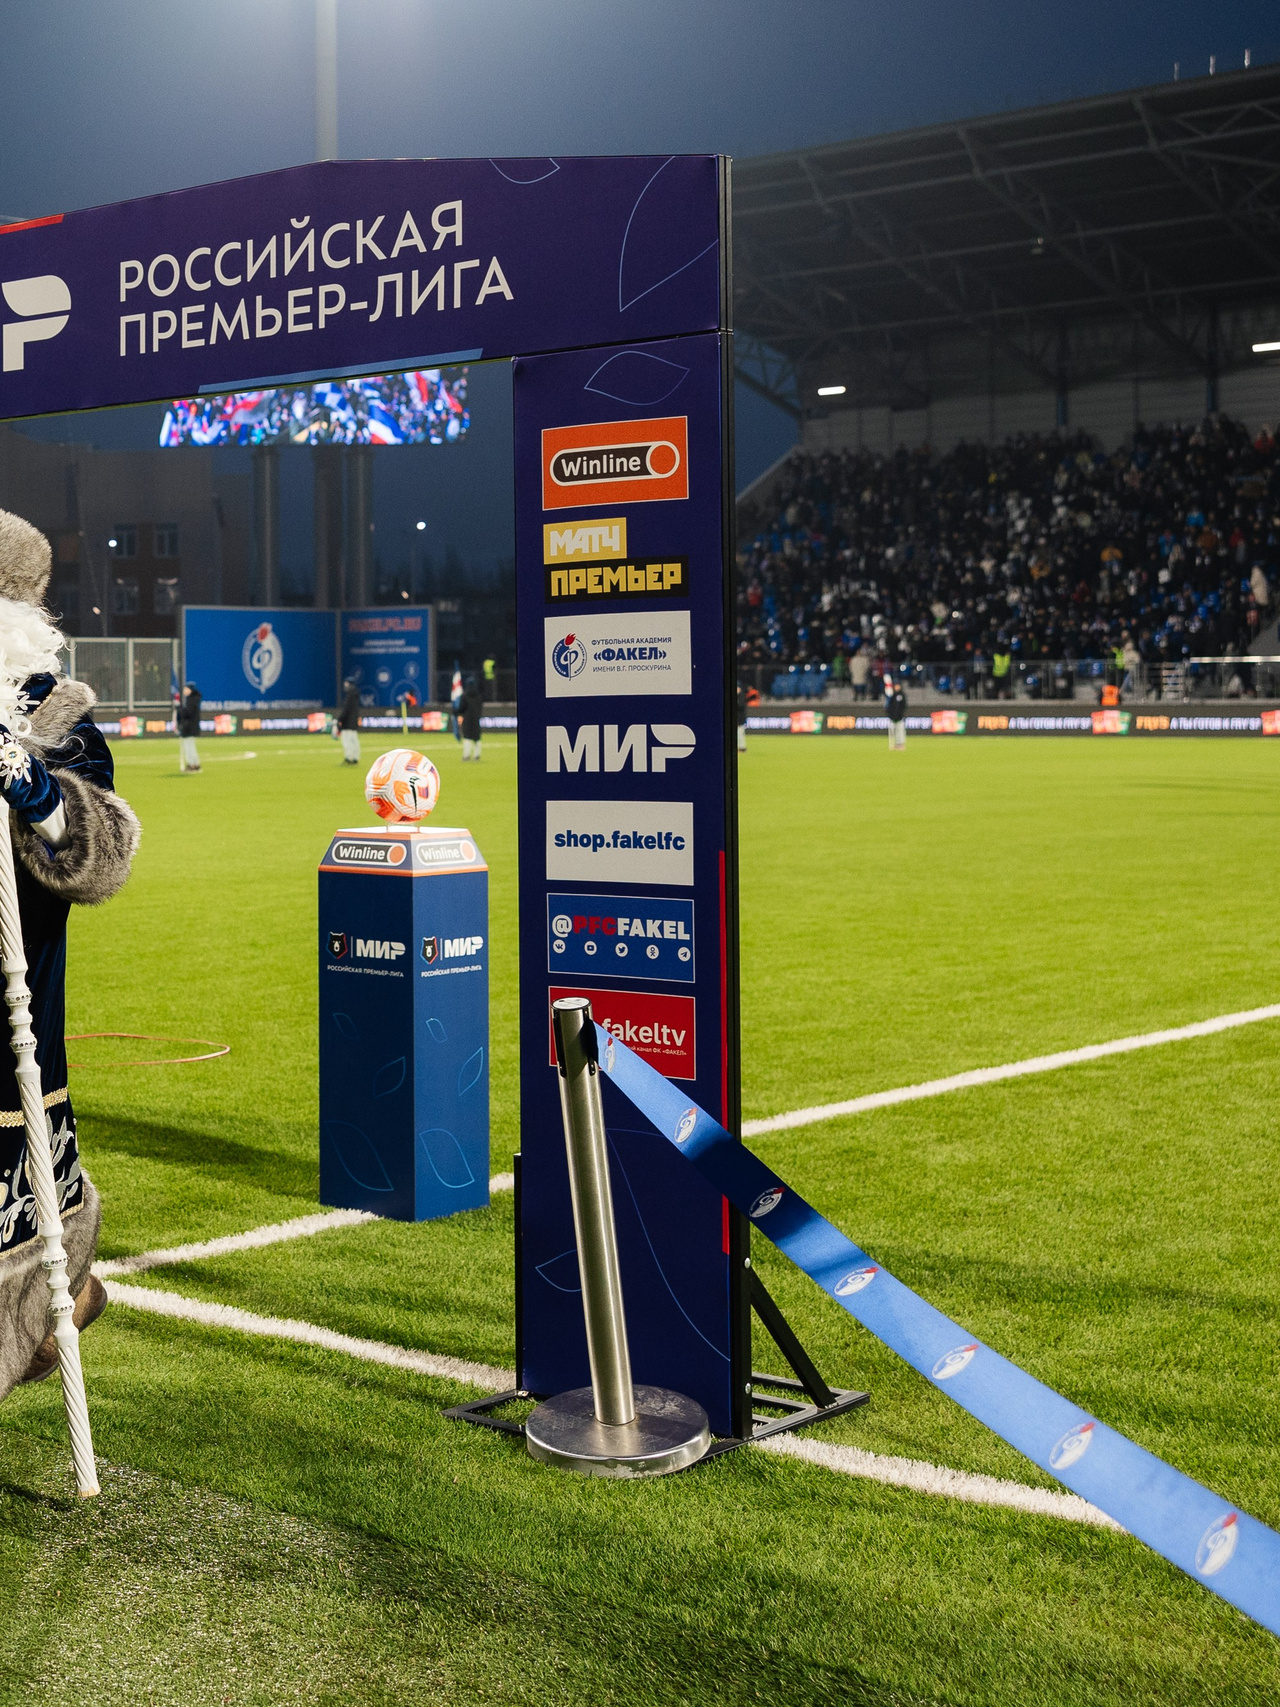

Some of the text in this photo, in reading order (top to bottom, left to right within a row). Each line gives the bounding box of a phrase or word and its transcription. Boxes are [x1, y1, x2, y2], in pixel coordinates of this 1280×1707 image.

[119, 200, 464, 303] РОССИЙСКАЯ
[119, 256, 515, 357] ПРЕМЬЕР-ЛИГА
[561, 453, 641, 477] Winline
[550, 525, 620, 556] МАТЧ
[551, 563, 682, 596] ПРЕМЬЕР
[591, 638, 635, 646] ФУТБОЛЬНАЯ
[593, 647, 667, 662] «ФАКЕЛ»
[545, 723, 697, 773] МИР
[339, 845, 386, 861] Winline
[554, 829, 686, 853] shop.fakelfc
[420, 846, 460, 861] Winline
[552, 914, 690, 940] @PFCFAKEL
[356, 938, 406, 960] МИР
[444, 935, 484, 959] МИР
[326, 964, 405, 978] РОССИЙСКАЯ ПРЕМЬЕР-ЛИГА
[420, 965, 483, 978] РОССИЙСКАЯ ПРЕМЬЕР-ЛИГА
[601, 1018, 687, 1047] fakeltv
